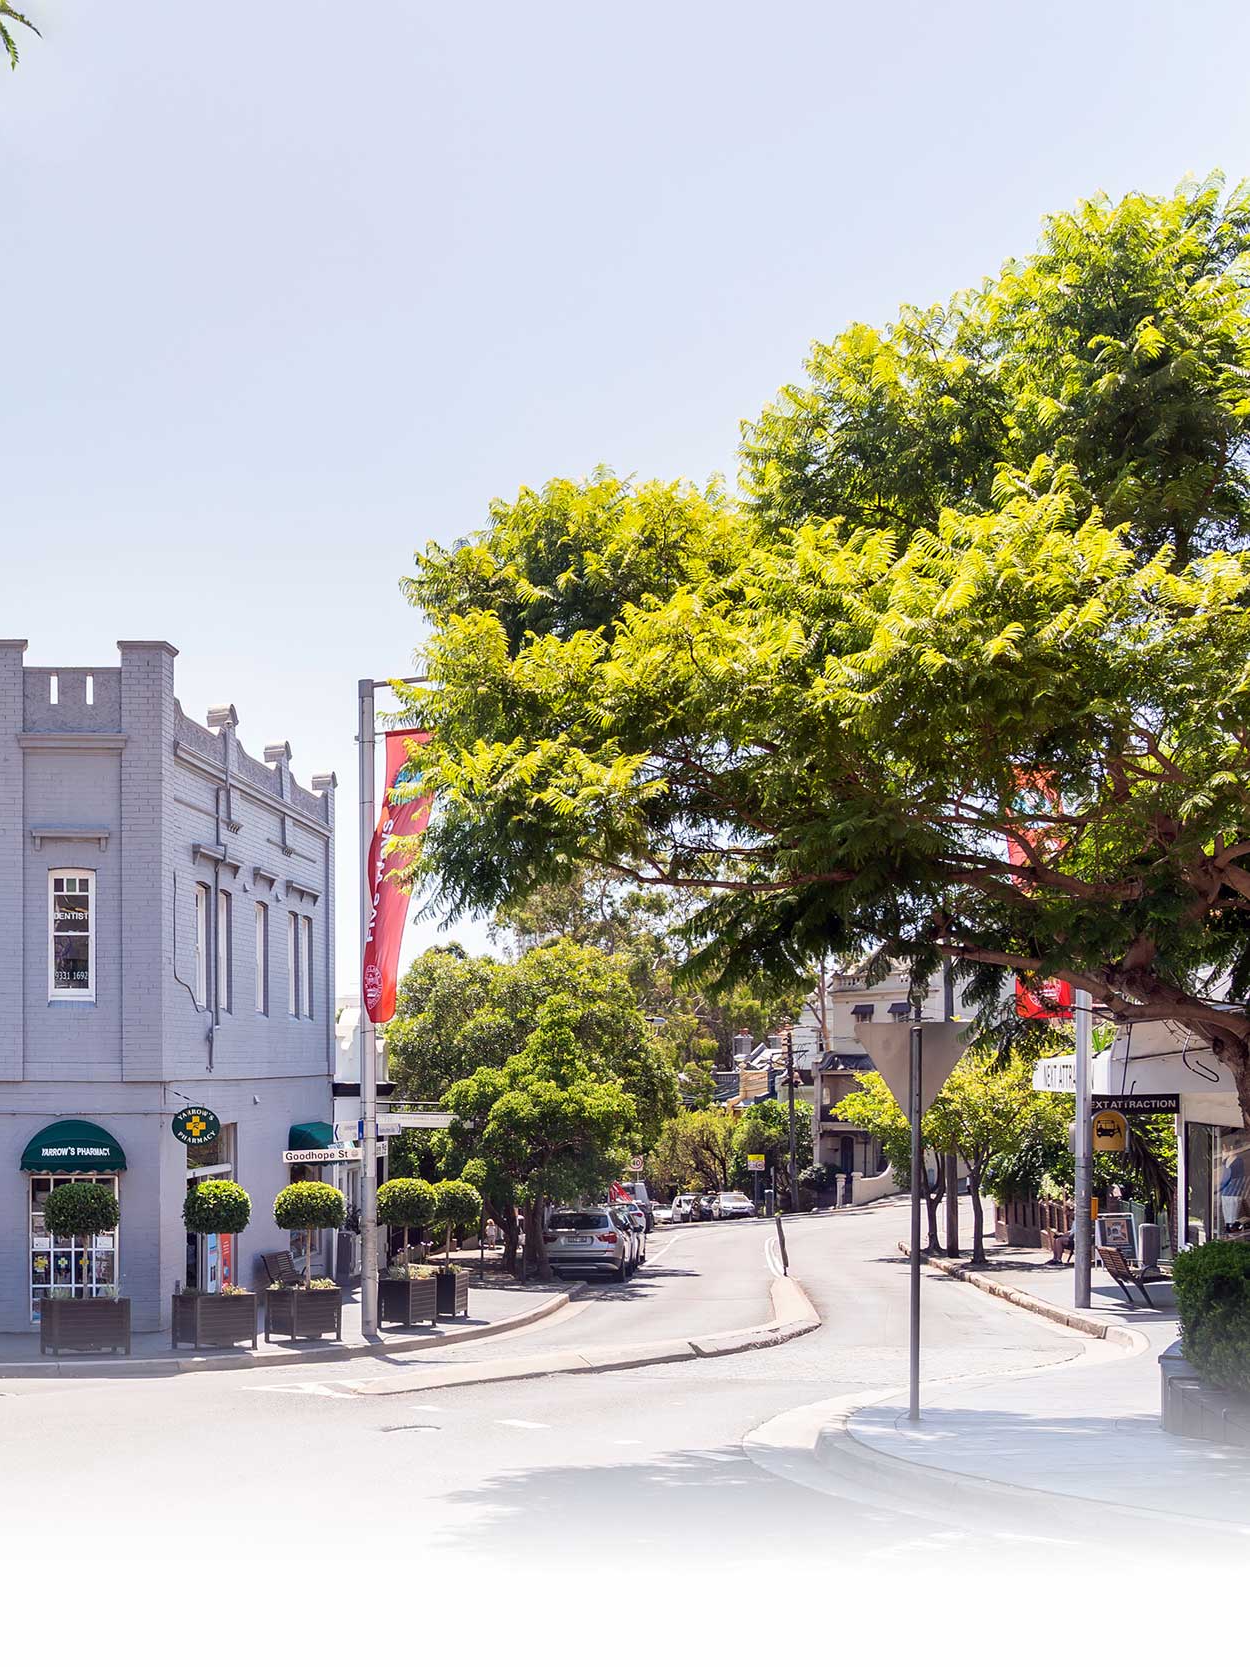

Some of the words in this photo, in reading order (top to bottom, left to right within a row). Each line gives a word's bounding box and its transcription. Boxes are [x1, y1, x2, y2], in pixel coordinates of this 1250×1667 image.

[54, 912, 88, 920] DENTIST
[1091, 1100, 1109, 1109] EXT
[1110, 1099, 1176, 1109] ATTRACTION
[177, 1109, 215, 1120] YARROW'S
[177, 1130, 216, 1144] PHARMACY
[41, 1147, 75, 1156] YARROW'S
[77, 1147, 110, 1156] PHARMACY
[285, 1151, 335, 1162] Goodhope
[338, 1150, 348, 1158] St
